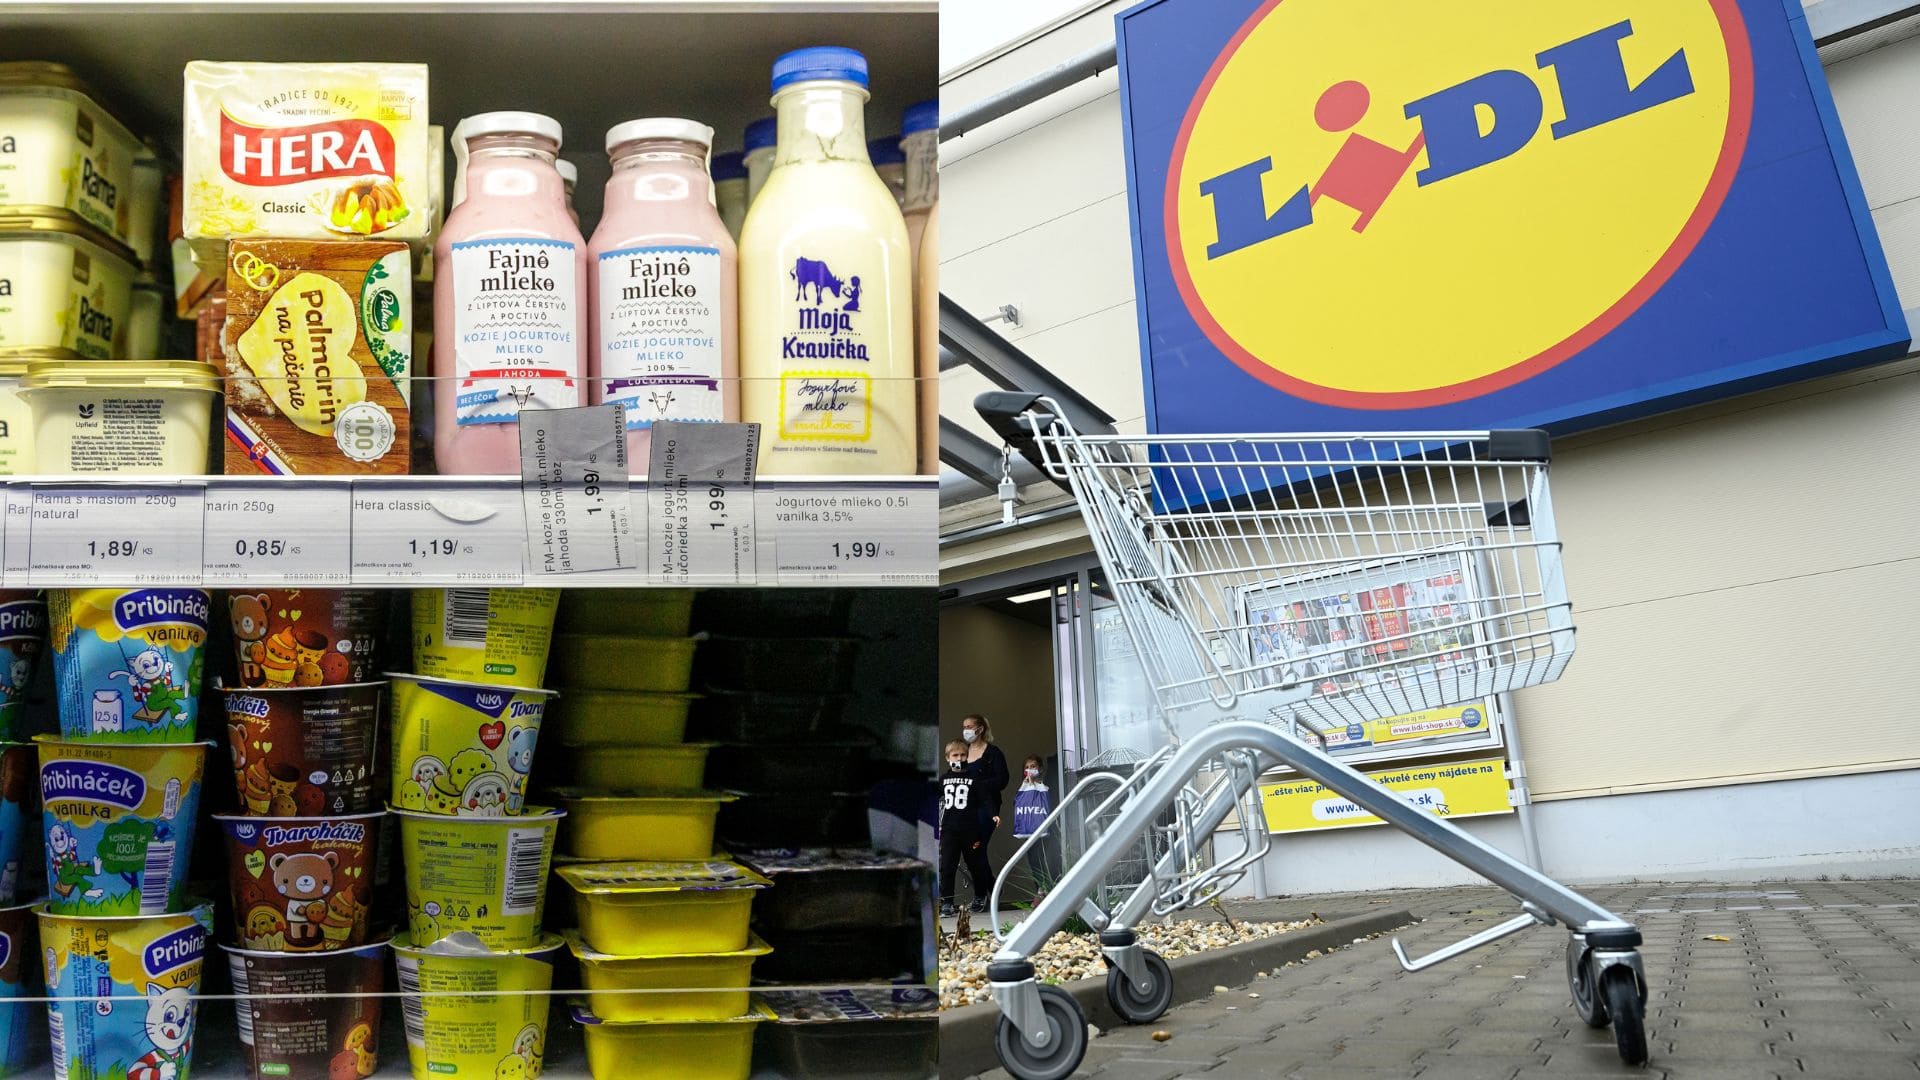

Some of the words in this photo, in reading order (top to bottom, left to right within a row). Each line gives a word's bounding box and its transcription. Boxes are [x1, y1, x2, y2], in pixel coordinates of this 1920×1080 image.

[257, 90, 307, 112] TRADICE
[314, 90, 328, 100] OD
[233, 129, 386, 178] HERA
[81, 158, 117, 210] Rama
[262, 202, 307, 214] Classic
[489, 249, 549, 274] Fajnô
[630, 257, 690, 282] Fajnô
[481, 270, 554, 292] mlieko
[622, 278, 697, 300] mlieko
[477, 301, 520, 310] LIPTOVA
[501, 312, 547, 320] POCTIVÔ
[619, 308, 660, 318] LIPTOVA
[78, 296, 114, 343] Rama
[276, 306, 292, 334] na
[799, 308, 854, 336] Moja
[464, 331, 500, 343] KOZIE
[503, 330, 571, 343] JOGURTOVÉ
[607, 340, 640, 351] KOZIE
[644, 337, 714, 349] JOGURTOVÉ
[300, 289, 342, 425] Palmarin
[496, 345, 543, 354] MLIEKO
[637, 351, 684, 361] MLIEKO
[782, 336, 870, 362] Kravička
[274, 338, 305, 411] pečenie
[499, 370, 541, 378] JAHODA
[647, 364, 675, 372] 100%
[803, 392, 849, 411] mlieko
[75, 418, 98, 430] Upfield
[344, 418, 354, 448] rokov
[355, 416, 374, 450] 100
[537, 428, 549, 504] jogurt.mlieko
[553, 461, 563, 481] bez
[664, 439, 677, 521] jogurt.mlieko
[35, 493, 72, 505] Rama
[76, 496, 83, 505] s
[87, 494, 137, 505] maslom
[145, 495, 177, 508] 250g
[556, 483, 566, 526] 330ml
[678, 474, 689, 514] 330ml
[775, 496, 837, 509] Jogurtové
[841, 496, 882, 507] mlieko
[33, 508, 79, 519] natural
[243, 500, 274, 514] 250g
[354, 499, 384, 510] Hera
[388, 500, 432, 511] classic
[776, 511, 819, 522] vanilka
[558, 527, 574, 574] jahoda
[123, 594, 209, 624] Pribináček
[95, 710, 111, 722] 125
[112, 712, 118, 724] g
[42, 770, 136, 800] Pribináček
[943, 778, 973, 786] BROOKLYN
[1379, 773, 1411, 785] skvelé
[1413, 771, 1436, 781] ceny
[1438, 767, 1478, 779] nájdete
[1479, 765, 1493, 773] na
[944, 784, 970, 810] 68
[1295, 784, 1314, 793] viac
[1016, 806, 1048, 815] NIVEA
[264, 821, 365, 847] Tvaroháčik
